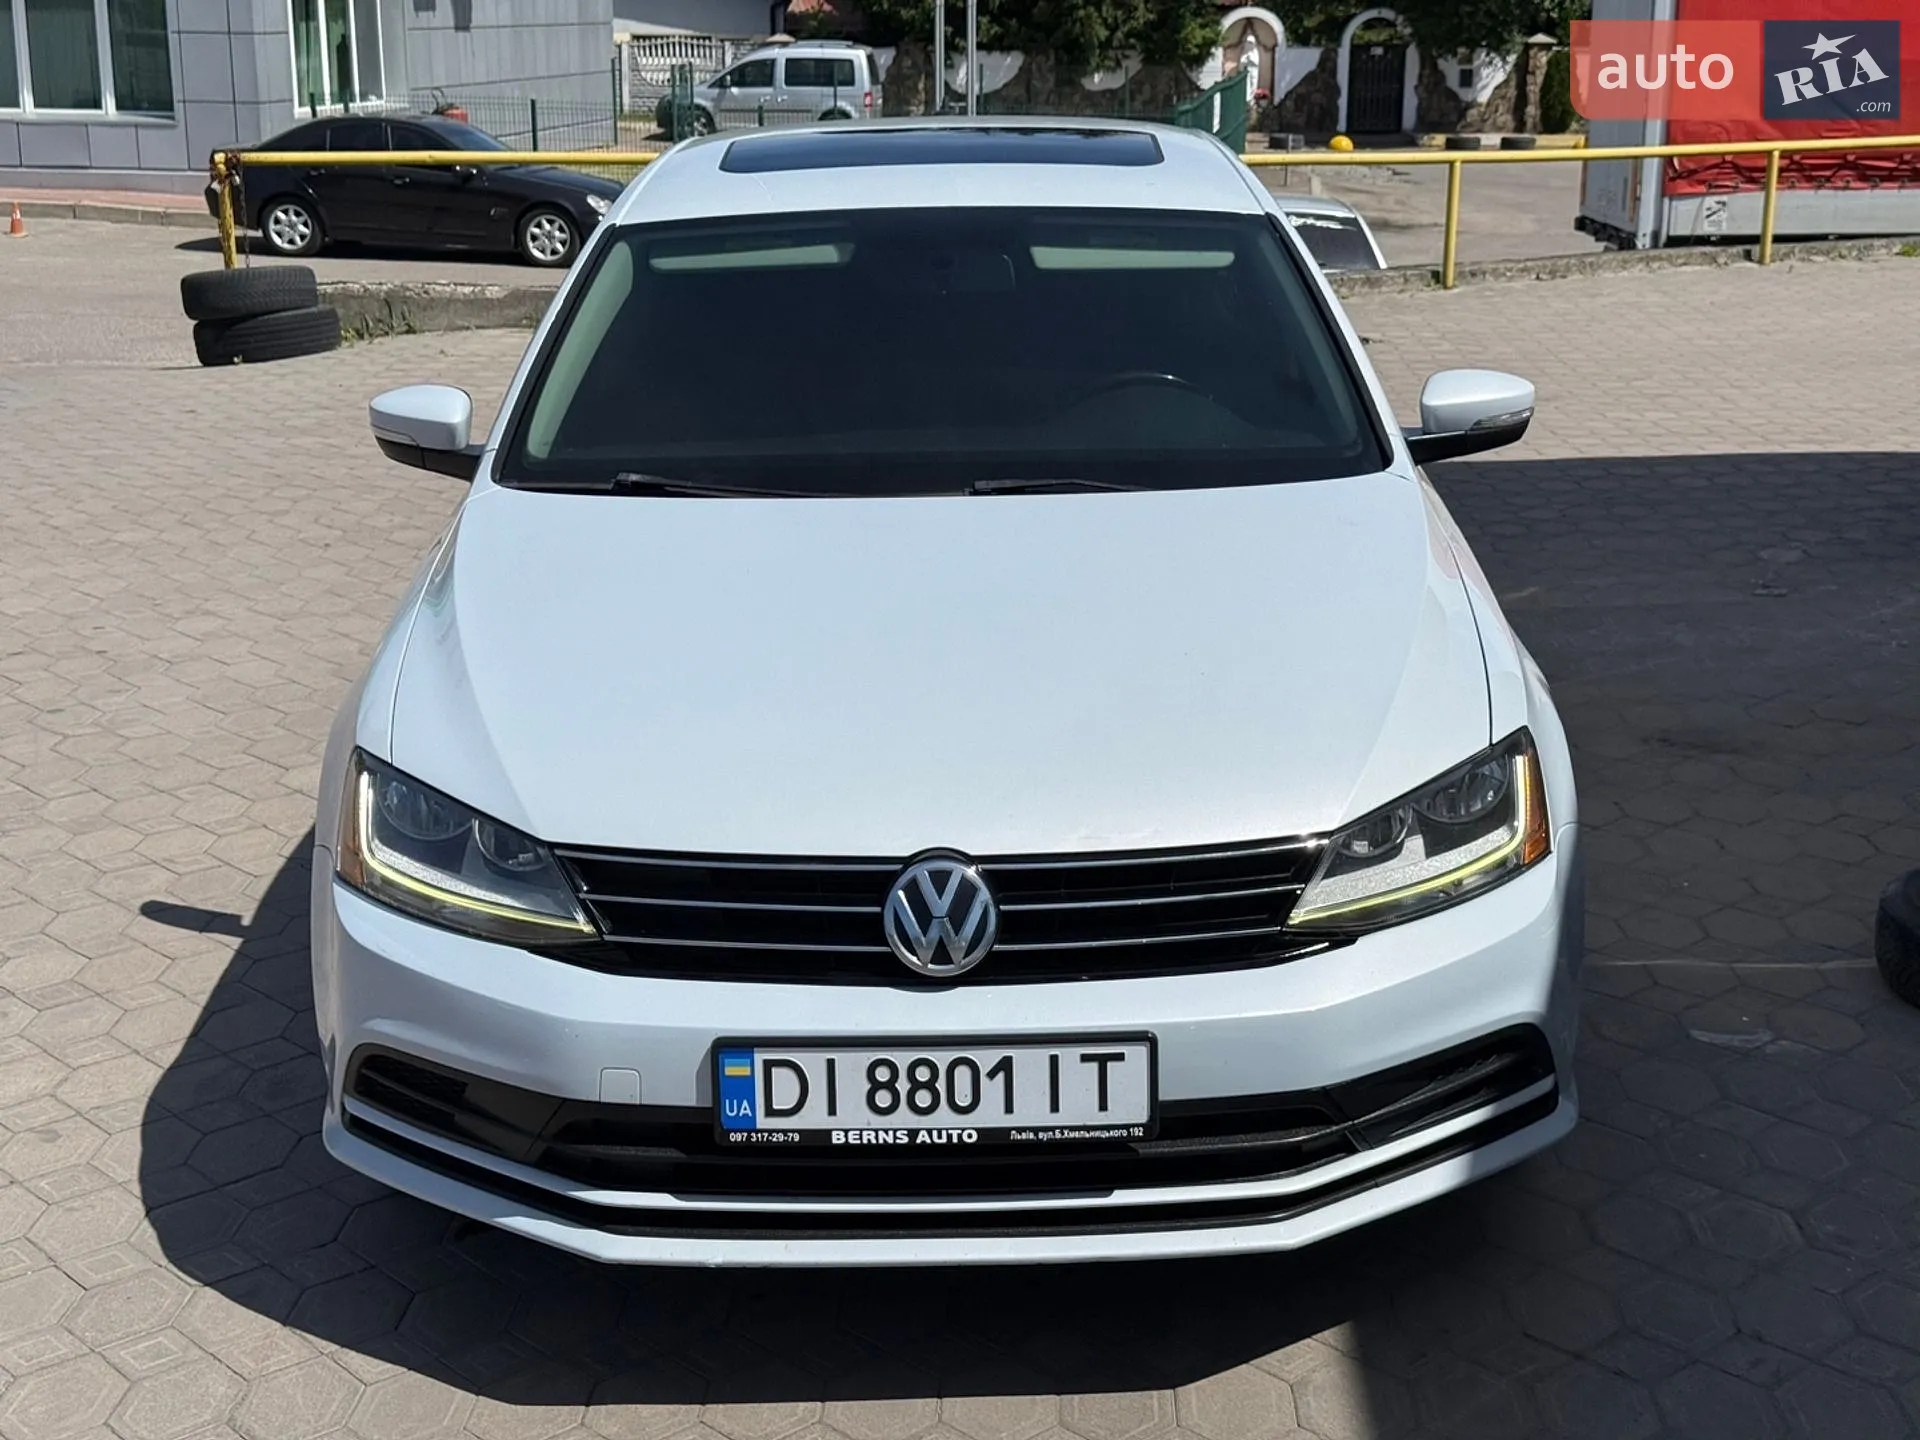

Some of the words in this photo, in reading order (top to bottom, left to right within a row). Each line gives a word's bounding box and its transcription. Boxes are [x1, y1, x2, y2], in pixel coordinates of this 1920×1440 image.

[763, 1057, 837, 1118] DI
[866, 1055, 1015, 1116] 8801
[1049, 1052, 1126, 1113] IT
[725, 1099, 752, 1117] UA
[729, 1132, 748, 1142] 097
[750, 1132, 800, 1142] 317-29-79
[831, 1130, 909, 1144] BERNS
[915, 1129, 978, 1143] AUTO
